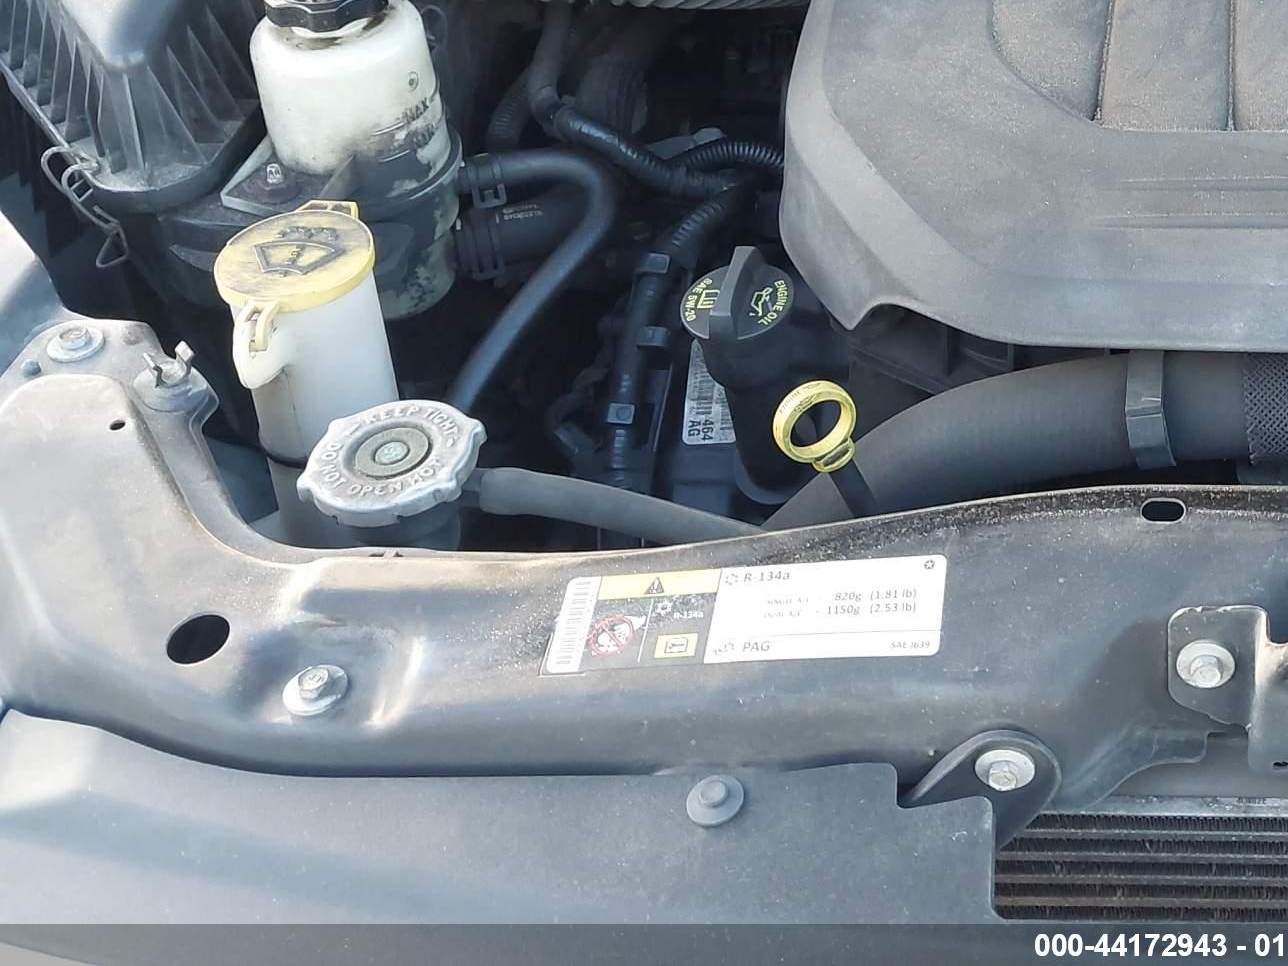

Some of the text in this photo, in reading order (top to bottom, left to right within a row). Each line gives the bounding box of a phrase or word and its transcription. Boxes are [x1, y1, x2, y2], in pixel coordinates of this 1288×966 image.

[684, 278, 712, 322] SAE 5W-20
[757, 280, 788, 325] ENGINE OIL
[362, 406, 419, 424] KEEP
[687, 419, 700, 437] AG
[701, 418, 714, 441] 464
[320, 442, 442, 496] DO NOT OPEN HOT
[834, 592, 862, 602] 820g
[827, 604, 861, 616] 1150g
[742, 640, 770, 652] PAG
